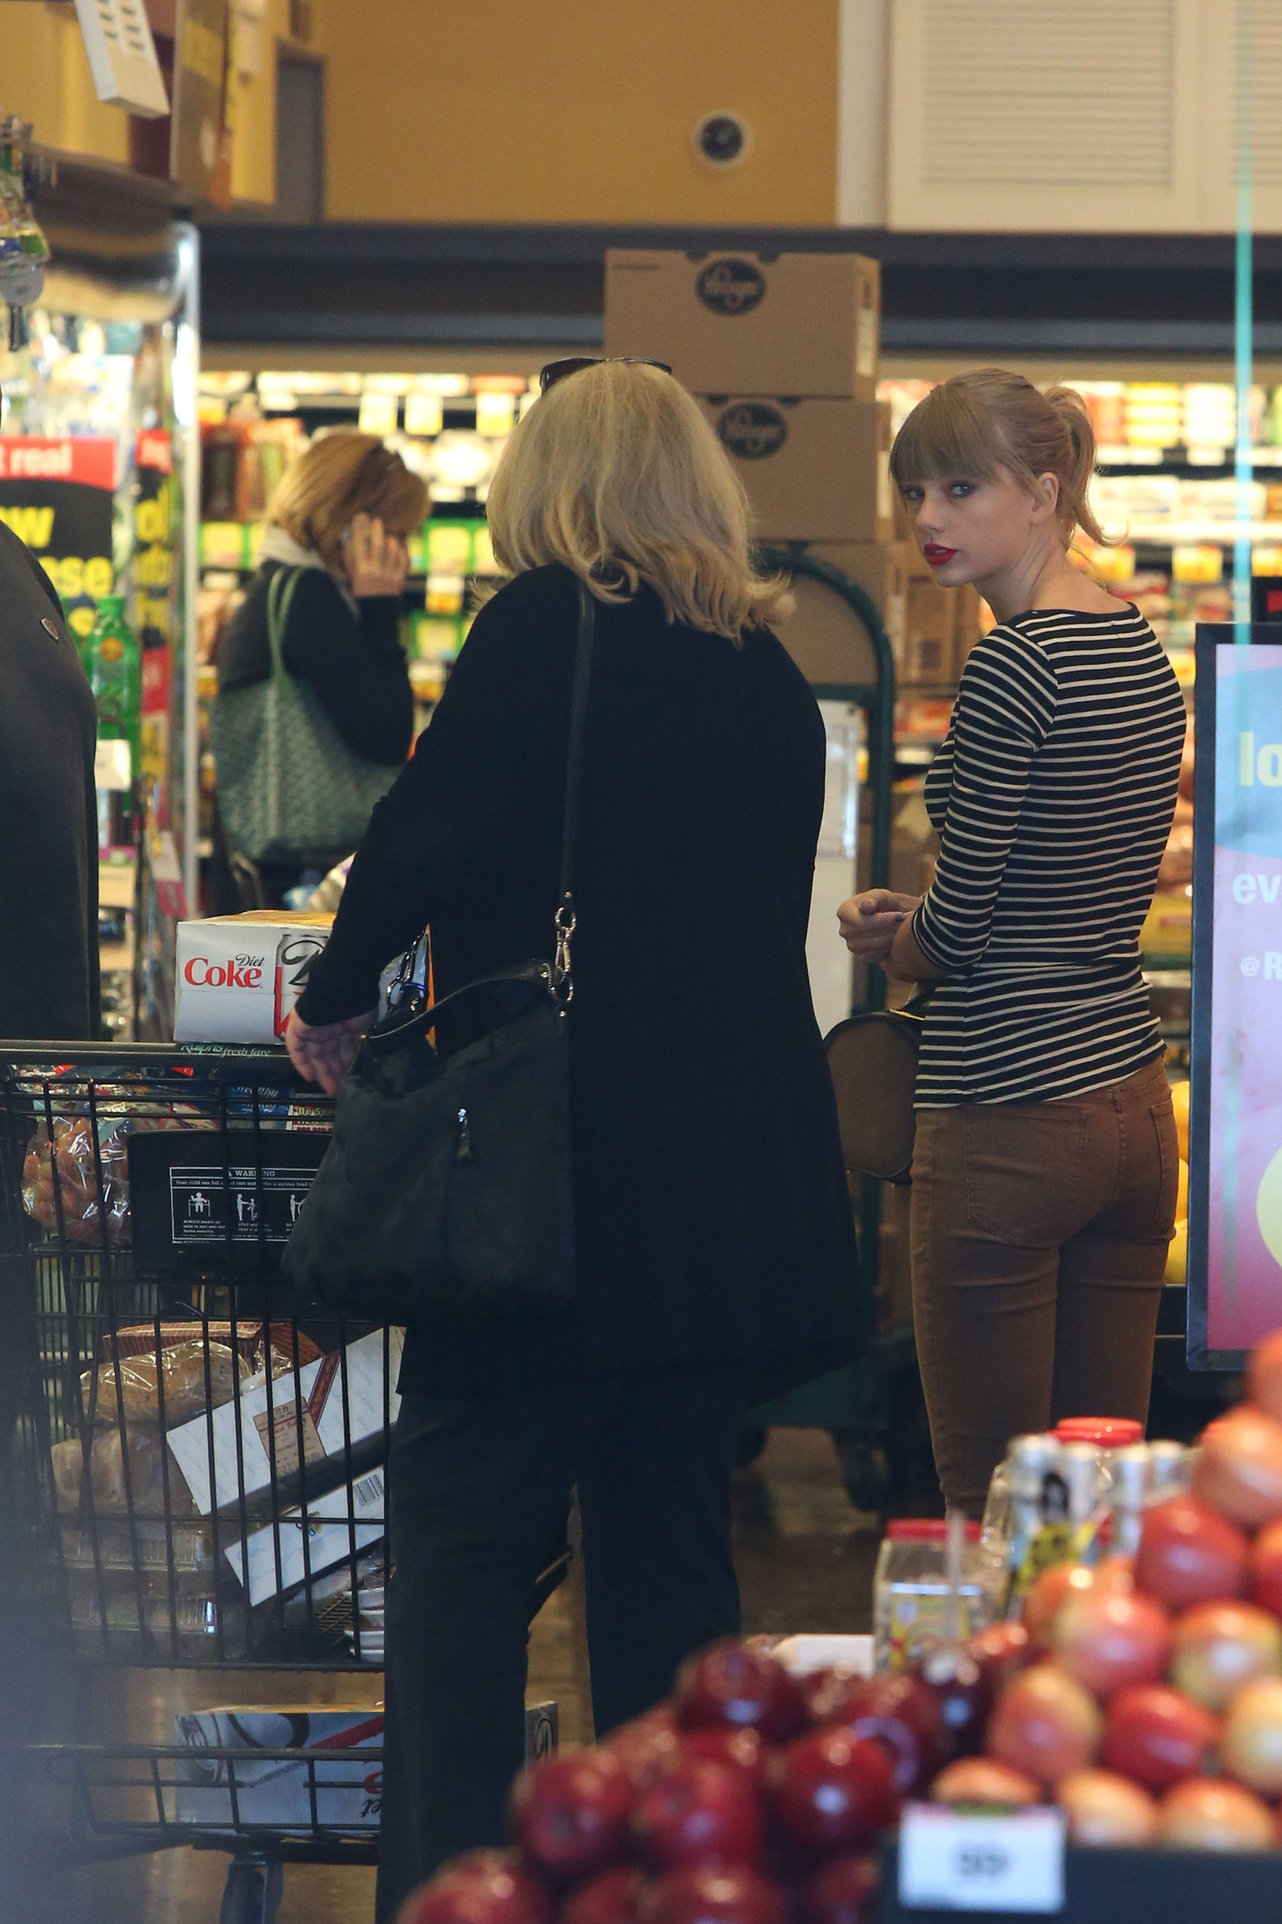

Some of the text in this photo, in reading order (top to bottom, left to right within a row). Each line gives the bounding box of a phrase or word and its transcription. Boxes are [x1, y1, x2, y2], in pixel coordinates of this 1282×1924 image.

[235, 953, 265, 968] Diet
[184, 957, 263, 989] Coke
[221, 1047, 248, 1058] fresh
[248, 1048, 271, 1058] fare
